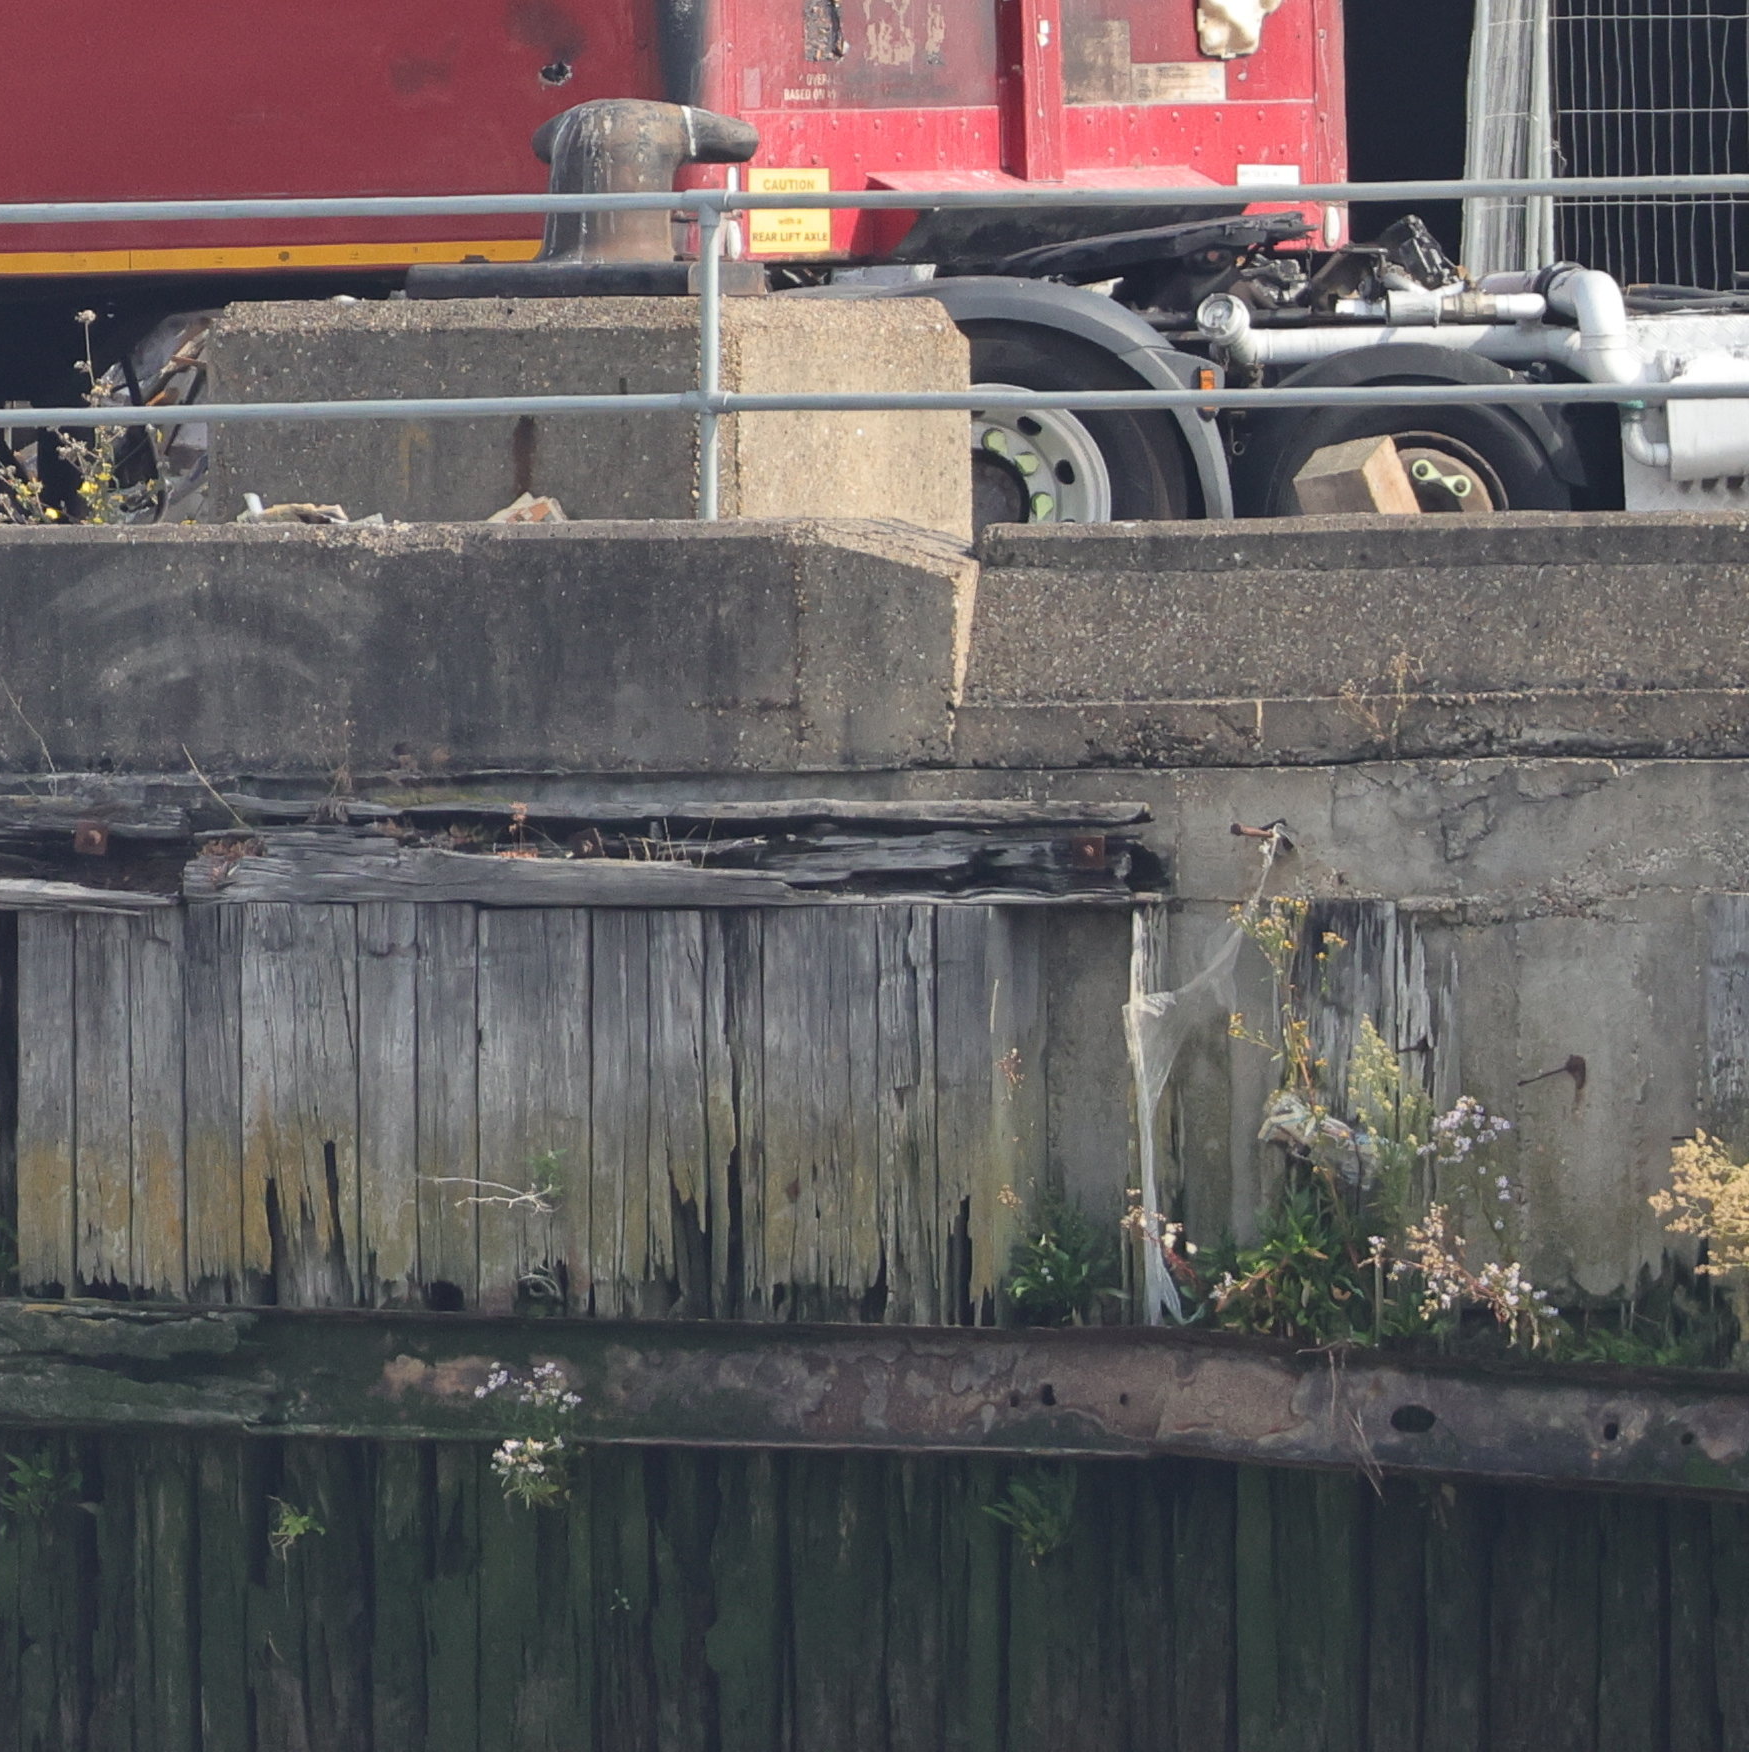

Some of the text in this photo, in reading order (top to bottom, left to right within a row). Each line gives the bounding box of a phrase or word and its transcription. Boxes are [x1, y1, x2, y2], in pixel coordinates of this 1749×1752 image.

[783, 88, 811, 101] BASED
[762, 178, 815, 191] CAUTION
[752, 232, 828, 242] REAR LIFT AXLE
